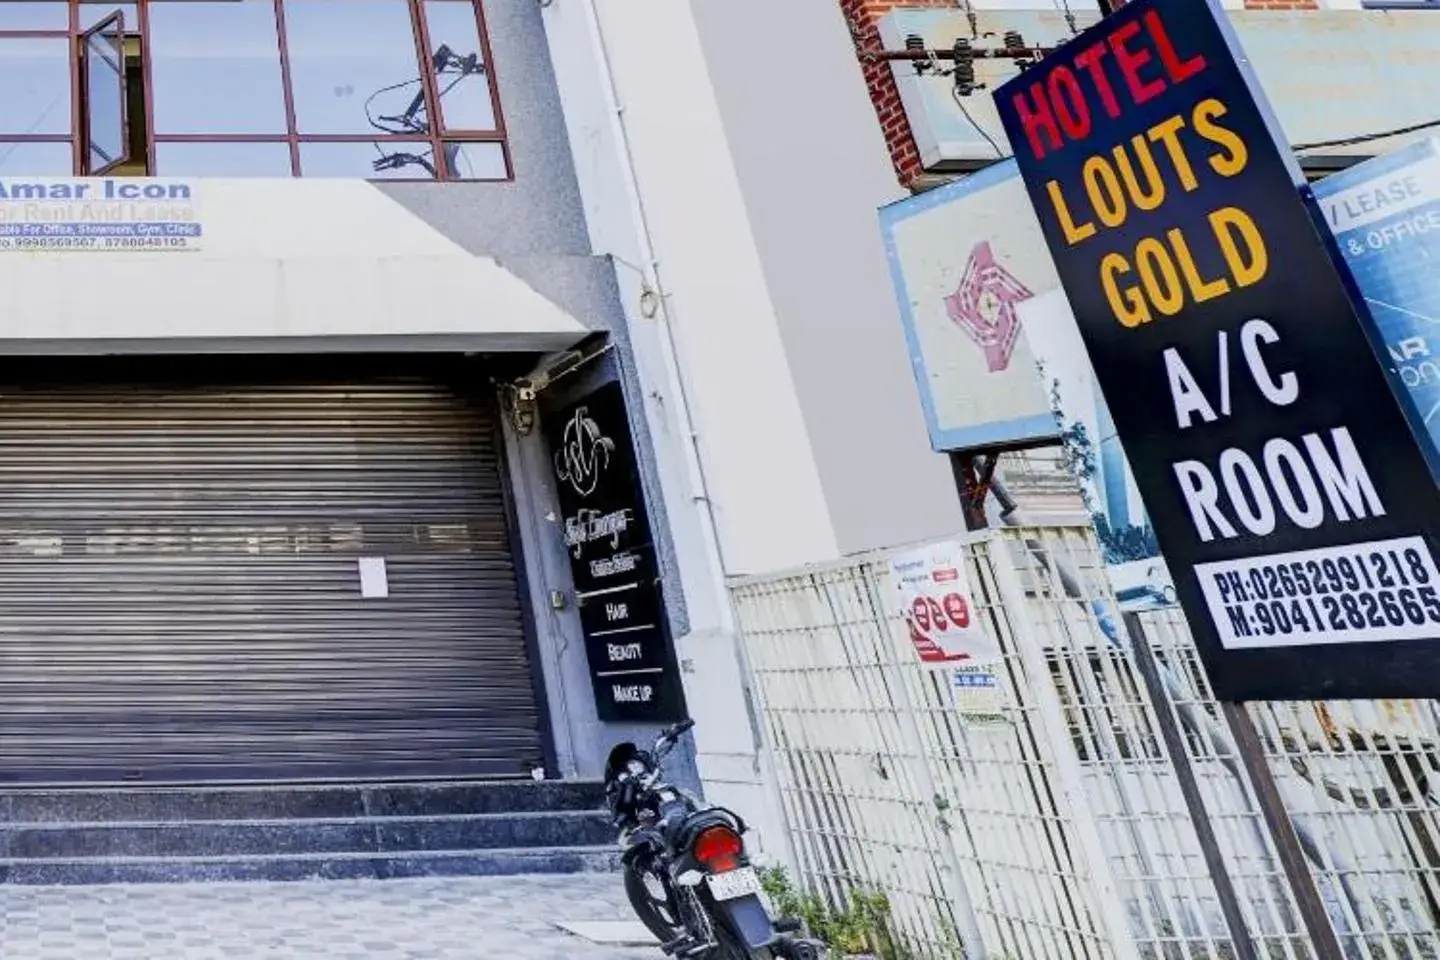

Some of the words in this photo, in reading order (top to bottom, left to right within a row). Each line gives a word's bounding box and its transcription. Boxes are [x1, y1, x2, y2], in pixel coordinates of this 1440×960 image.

[1012, 8, 1207, 160] HOTEL
[104, 178, 191, 199] Icon
[1046, 97, 1250, 246] LOUTS
[1344, 175, 1422, 219] LEASE
[1099, 206, 1269, 329] GOLD
[1162, 317, 1300, 430] A/C
[1172, 425, 1387, 543] ROOM
[1213, 547, 1430, 604] PH:02652991218
